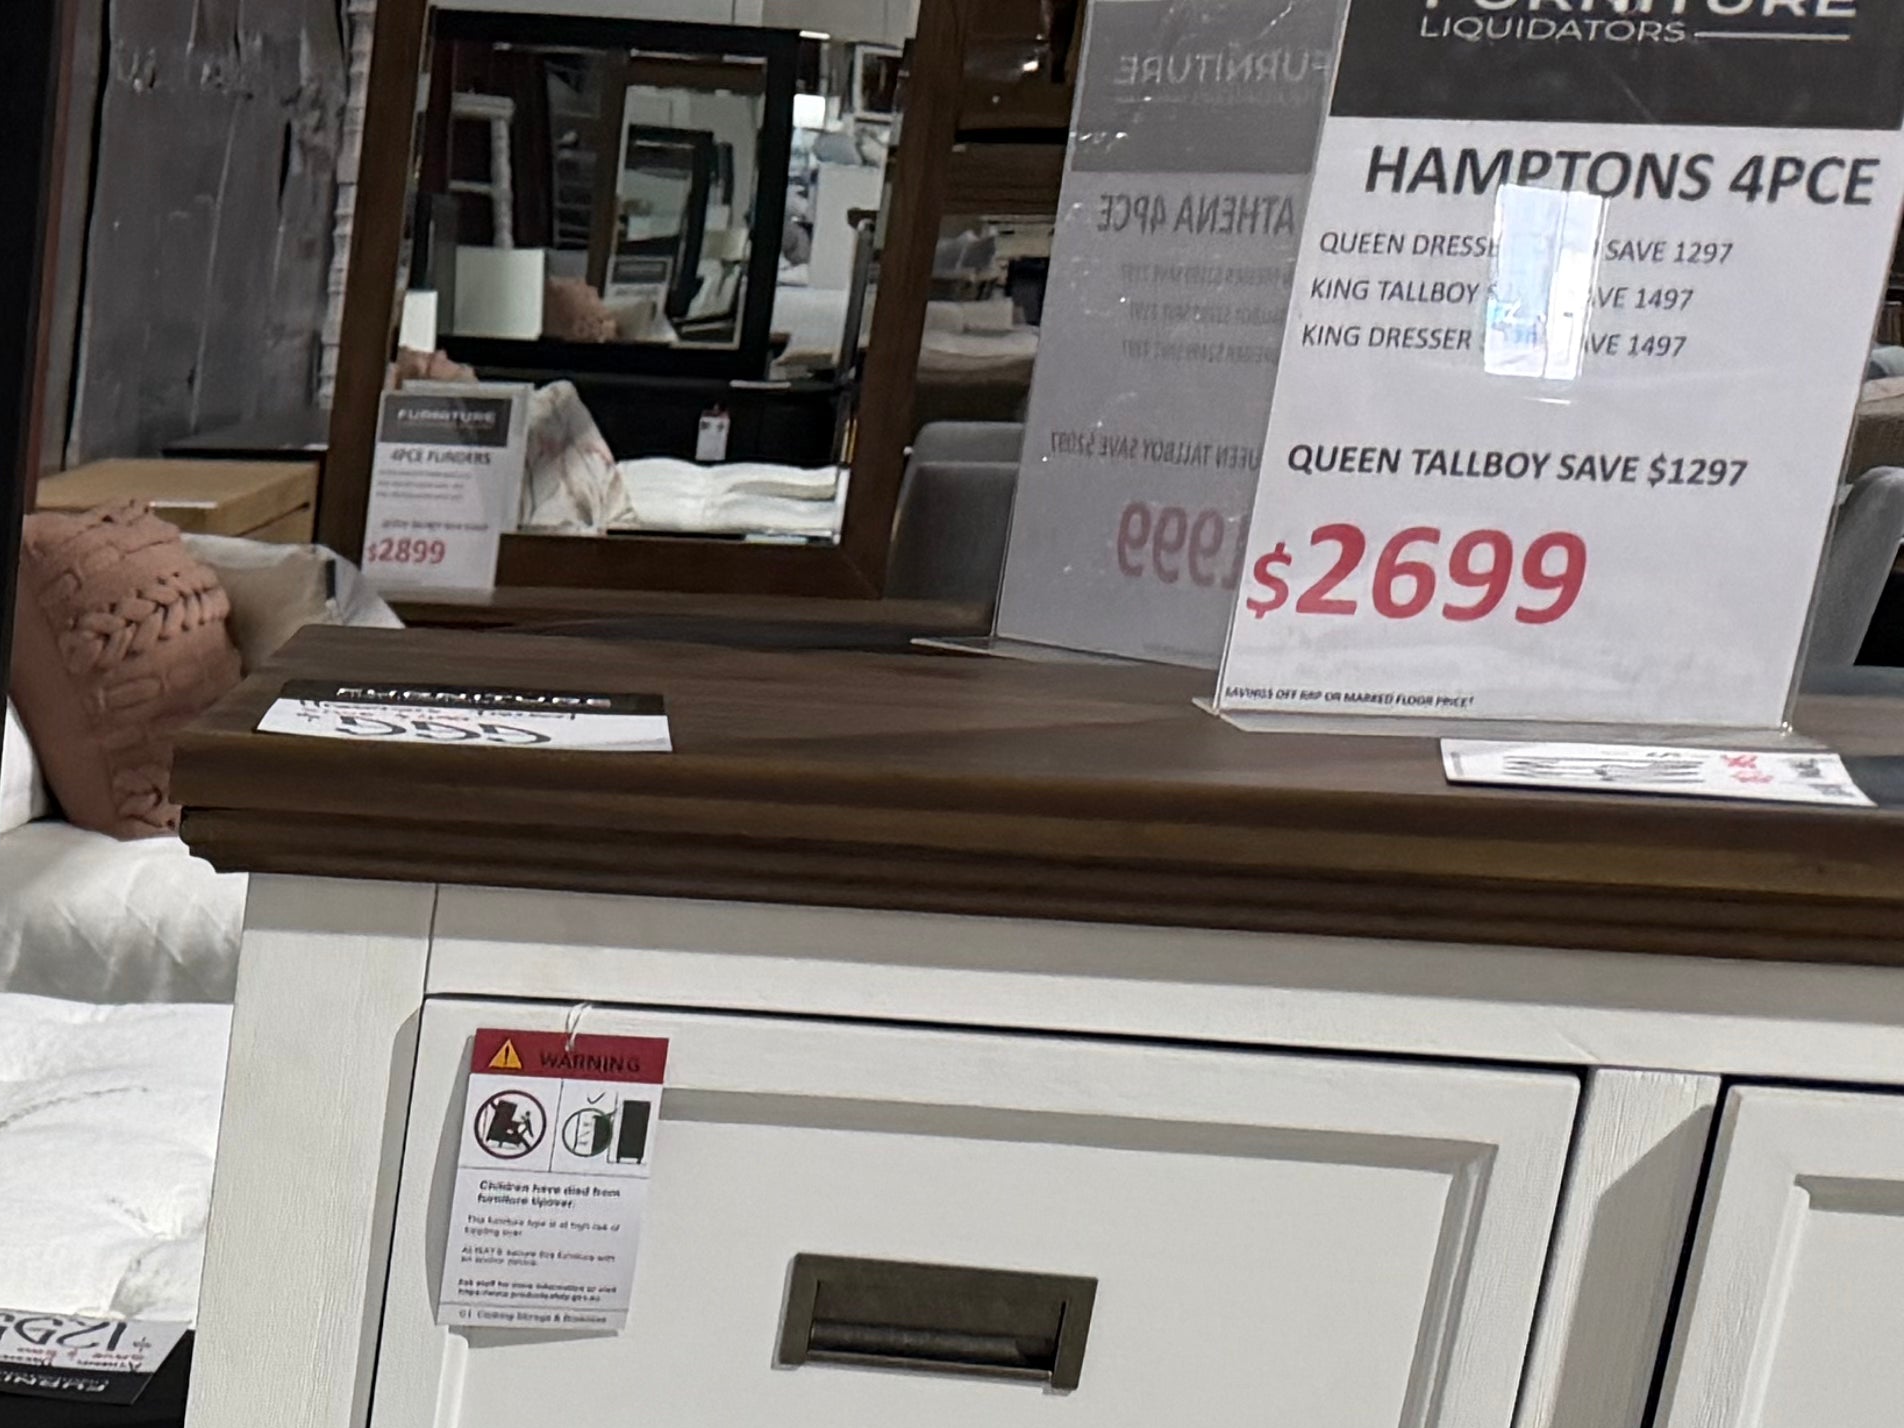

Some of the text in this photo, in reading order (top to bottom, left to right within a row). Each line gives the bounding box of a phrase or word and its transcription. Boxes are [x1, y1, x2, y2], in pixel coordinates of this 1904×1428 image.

[1420, 15, 1687, 42] LIQUIDATORS
[1365, 145, 1881, 206] HAMPTONS 4PCE
[1319, 231, 1406, 255] QUEEN
[1604, 239, 1667, 263] SAVE
[1673, 241, 1734, 265] 1297
[1310, 276, 1370, 301] KING
[1378, 279, 1480, 305] TALLBOY
[1635, 288, 1694, 311] 1497
[1301, 323, 1361, 348] KING
[1367, 326, 1473, 351] DRESSER
[1627, 334, 1688, 357] 1497
[1287, 444, 1748, 489] QUEEN TALLBOY SAVE $1297
[367, 537, 446, 565] $2899
[1245, 522, 1589, 626] $2699
[541, 1053, 640, 1073] WARNING
